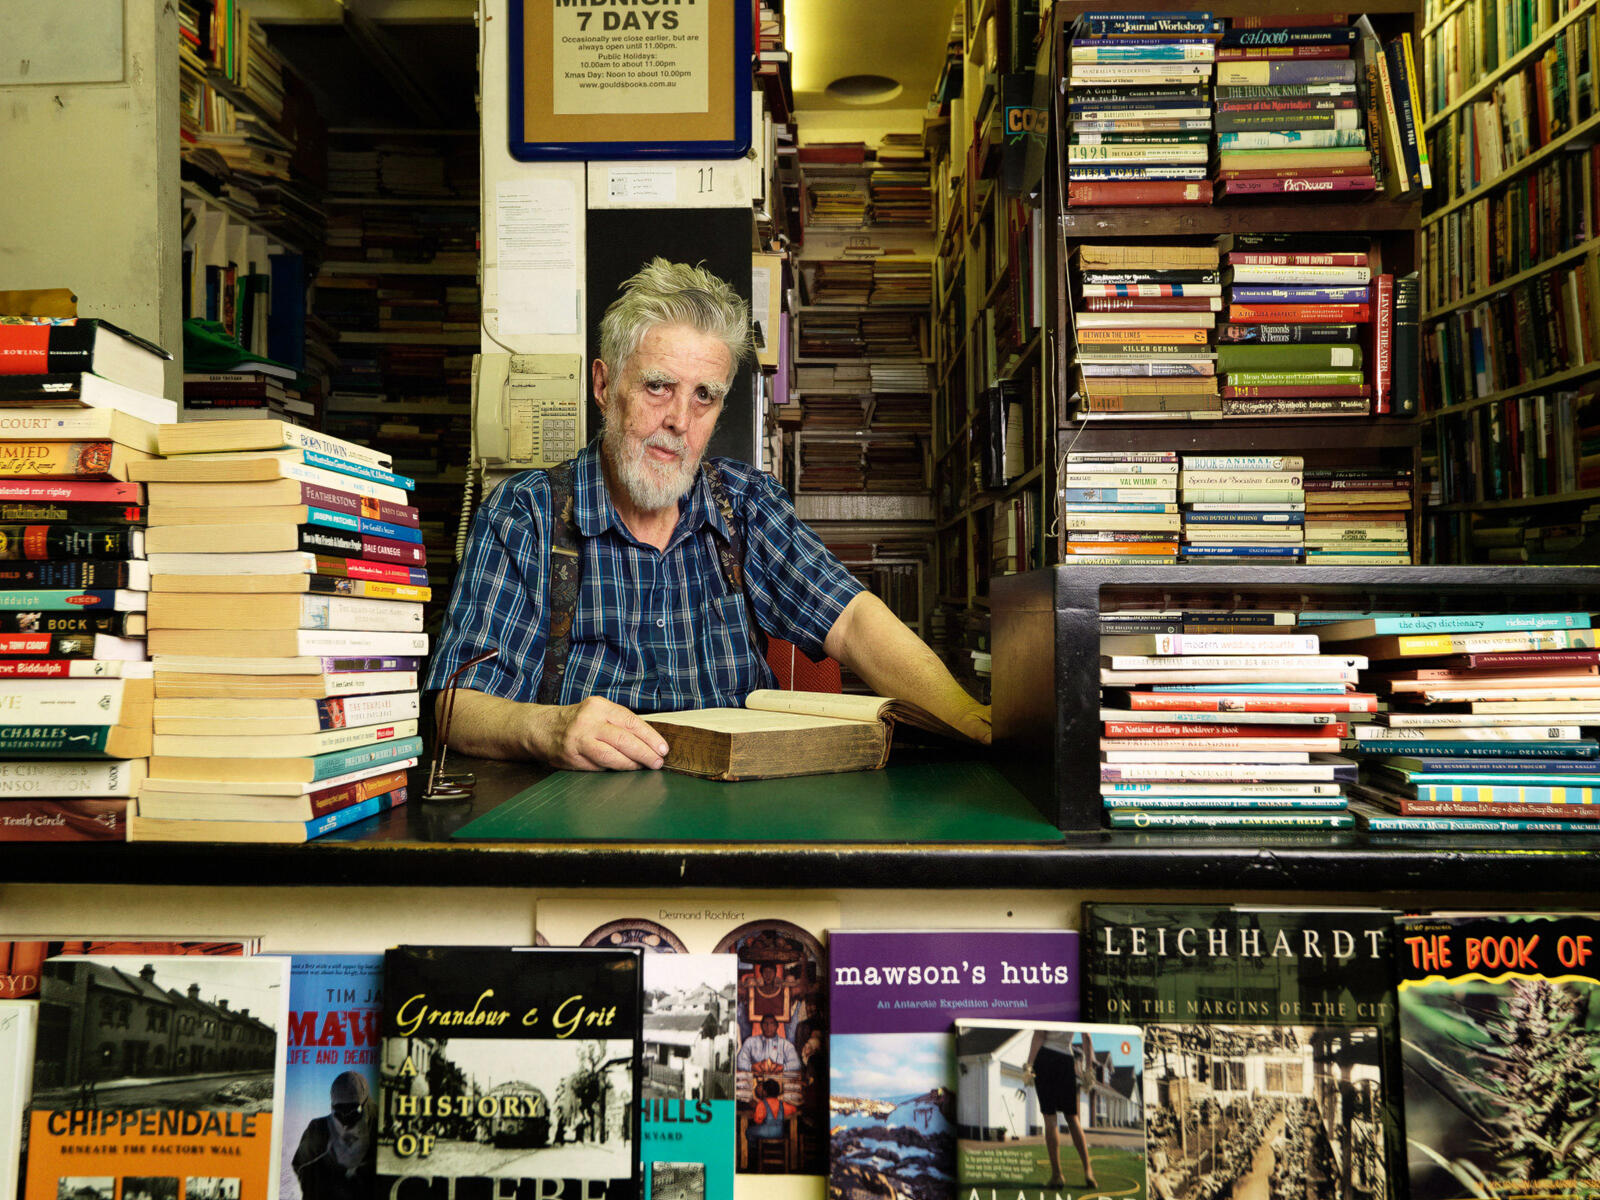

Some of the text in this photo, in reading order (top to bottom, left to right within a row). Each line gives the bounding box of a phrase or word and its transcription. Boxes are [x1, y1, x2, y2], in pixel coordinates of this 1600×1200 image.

[577, 11, 679, 31] 7 DAYS
[1123, 20, 1205, 32] Journal Workshop
[562, 36, 609, 44] Occasionally
[645, 34, 671, 42] earlier,
[623, 52, 658, 60] Holidays:
[645, 60, 676, 69] 11.00pm
[564, 71, 586, 79] Xmas
[587, 71, 605, 79] Day:
[637, 70, 659, 78] about
[660, 70, 692, 78] 10.00pm
[579, 80, 677, 89] www.gouldsbooks.com.au
[1228, 86, 1281, 98] THE TEUTONIC
[1223, 101, 1271, 111] Conquest of the
[1072, 147, 1108, 160] 1929
[1073, 168, 1147, 178] THESE WOMEN
[697, 166, 714, 193] 11
[1245, 256, 1258, 264] THE
[1273, 256, 1287, 264] WEB
[1296, 256, 1310, 264] TOM
[1311, 256, 1333, 264] BOWER
[1083, 331, 1110, 339] BETWEEN
[1260, 324, 1290, 334] Diamonds
[1380, 293, 1389, 372] LIVING THEATER
[1260, 333, 1290, 342] & Demons
[1331, 481, 1346, 489] JFK
[46, 488, 72, 498] ripley
[305, 486, 357, 508] FEATHERSTONE
[313, 512, 358, 527] JOSEPH MITCHELL
[364, 543, 401, 557] DALE CARNEGIE
[48, 619, 87, 630] BOCK
[1399, 619, 1412, 629] the
[1438, 618, 1485, 631] dictionary
[1184, 640, 1219, 649] modern
[17, 663, 62, 674] Biddulph
[1, 727, 67, 738] CHARLES
[1110, 725, 1123, 733] The
[1124, 725, 1154, 733] National
[1155, 725, 1180, 735] Gallery
[1221, 725, 1239, 733] Book
[1369, 728, 1425, 738] THE KISS
[3, 813, 66, 827] Tenth Circle
[1499, 822, 1519, 830] TIME
[658, 909, 746, 920] Desmond Rochfort
[1105, 927, 1385, 960] LEICHHARDT
[1403, 934, 1593, 971] THE BOOK OF
[835, 961, 1069, 985] mawson's huts
[326, 988, 356, 1004] TIM
[877, 998, 1029, 1010] An Antarctic Expedition Journal
[1107, 999, 1391, 1017] ON THE MARGINS OF THE CIT
[395, 988, 616, 1039] Grandeur Grit
[315, 1049, 338, 1065] AND
[400, 1056, 417, 1077] A
[399, 1095, 541, 1119] HISTORY
[48, 1110, 257, 1138] CHIPPENDALE
[61, 1144, 242, 1157] BENEATH THE FACTORY WALL
[397, 1134, 437, 1158] OF
